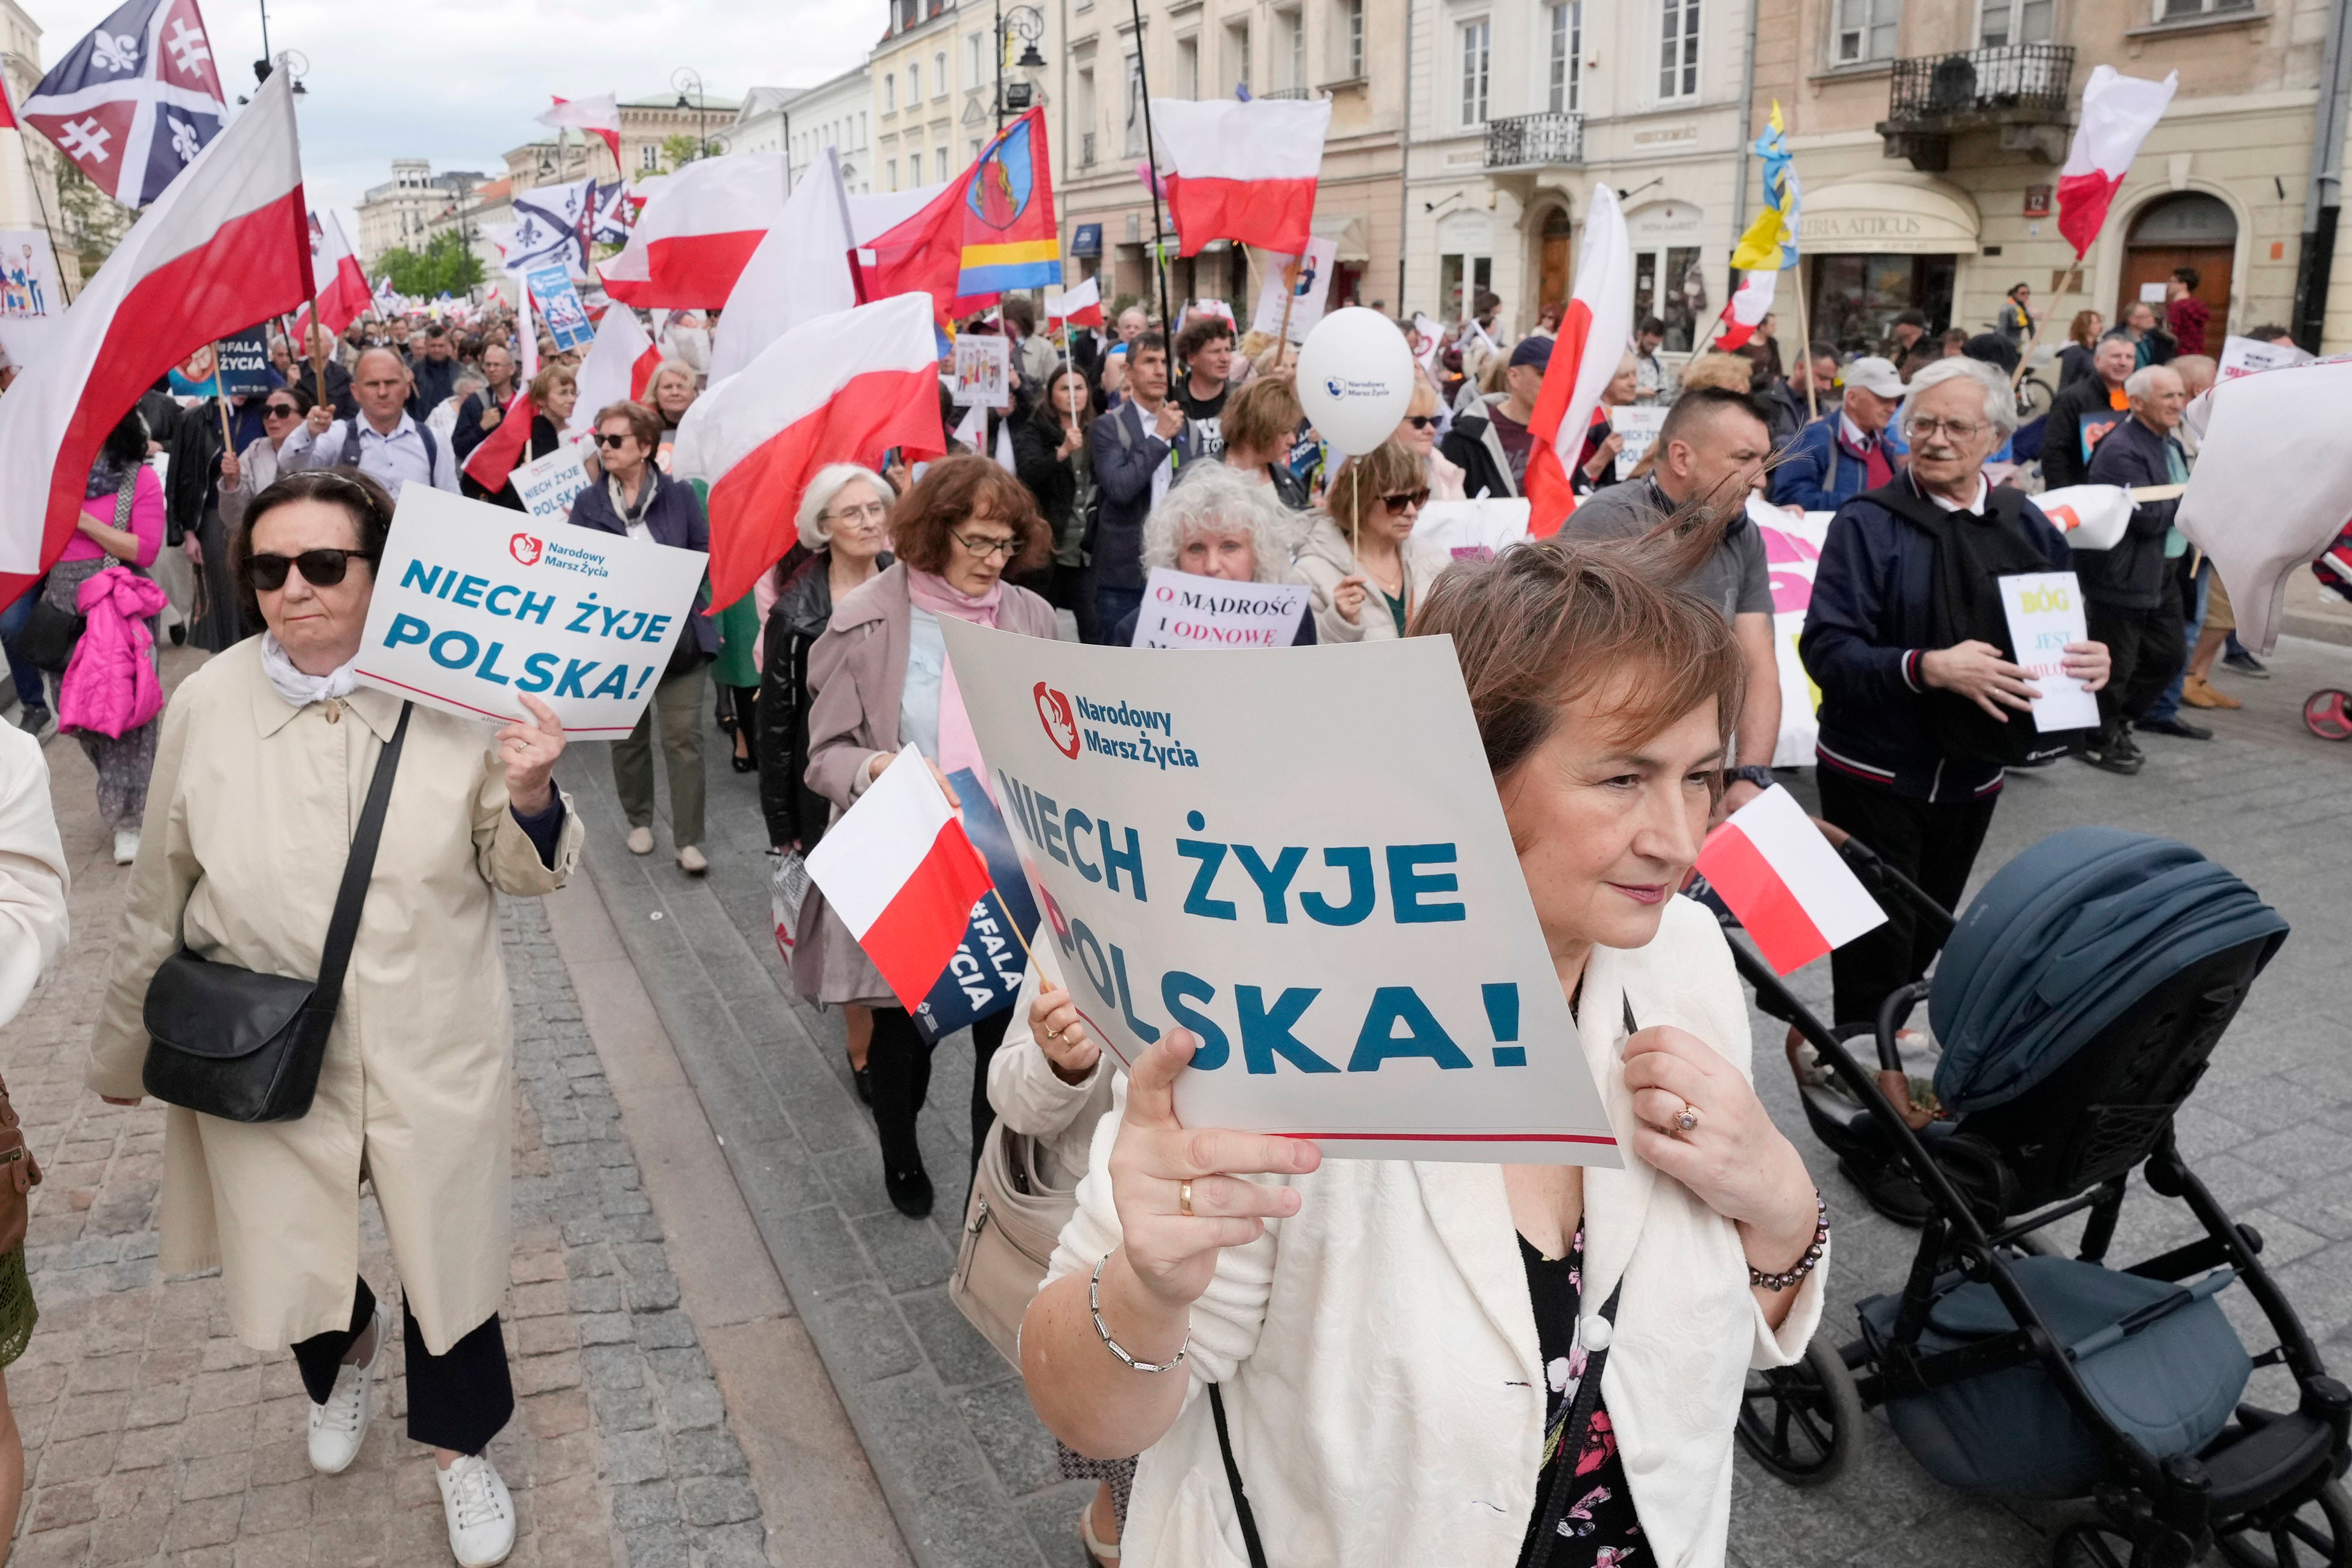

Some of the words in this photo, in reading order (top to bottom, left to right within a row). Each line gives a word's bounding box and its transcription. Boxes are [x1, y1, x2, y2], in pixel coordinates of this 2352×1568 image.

[219, 353, 266, 370] ŻYCIA
[524, 478, 553, 501] NIECH
[554, 464, 580, 485] ŻYJE
[545, 555, 579, 571] Marsz
[580, 561, 609, 578] Życia
[548, 542, 605, 565] Narodowy
[399, 558, 557, 625] NIECH
[564, 592, 672, 643] ŻYJE
[1156, 586, 1174, 602] O
[1179, 591, 1297, 616] MĄDROŚĆ
[2020, 582, 2070, 615] BÓG
[1159, 616, 1168, 631] I
[1174, 621, 1277, 646] ODNOWĘ
[2035, 631, 2072, 650] JEST
[382, 612, 656, 700] POLSKA!
[1075, 695, 1171, 737] Narodowy
[1083, 729, 1139, 761] Marsz
[1139, 731, 1200, 771] Życia
[997, 768, 1147, 903] NIECH
[1176, 810, 1467, 926] ŻYJE
[970, 900, 1024, 992] #FALA
[949, 943, 994, 1013] CIA
[1038, 883, 1527, 1075] POLSKA!
